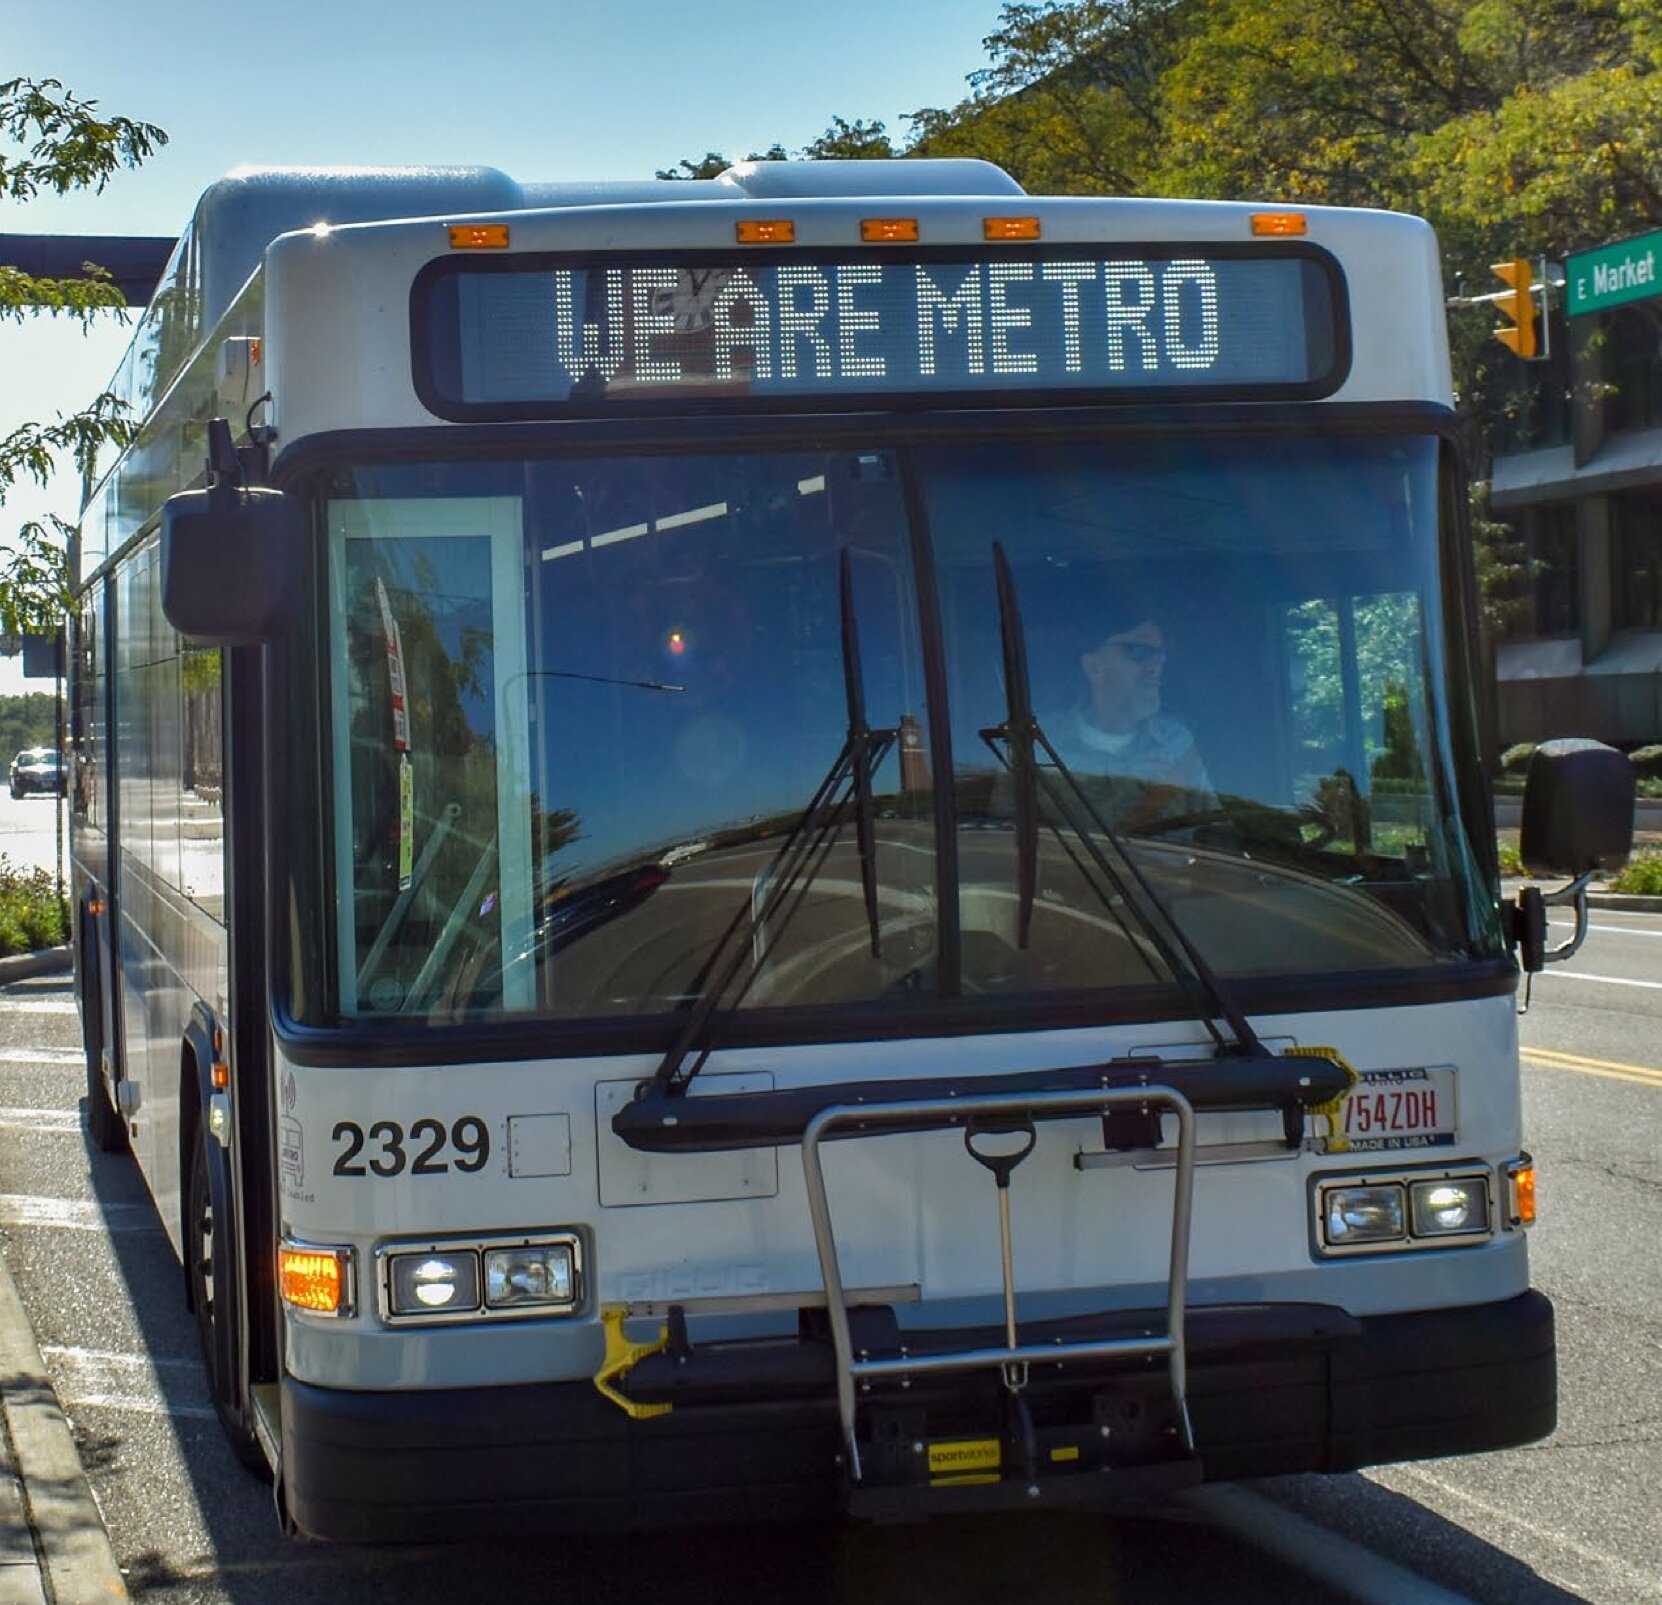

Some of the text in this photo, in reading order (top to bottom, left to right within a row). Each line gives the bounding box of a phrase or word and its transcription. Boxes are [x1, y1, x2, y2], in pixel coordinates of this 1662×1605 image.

[1577, 250, 1656, 300] E Market
[555, 258, 1219, 383] WE ARE METRO
[331, 1115, 491, 1177] 2329
[1350, 1136, 1429, 1151] MADE IN USA
